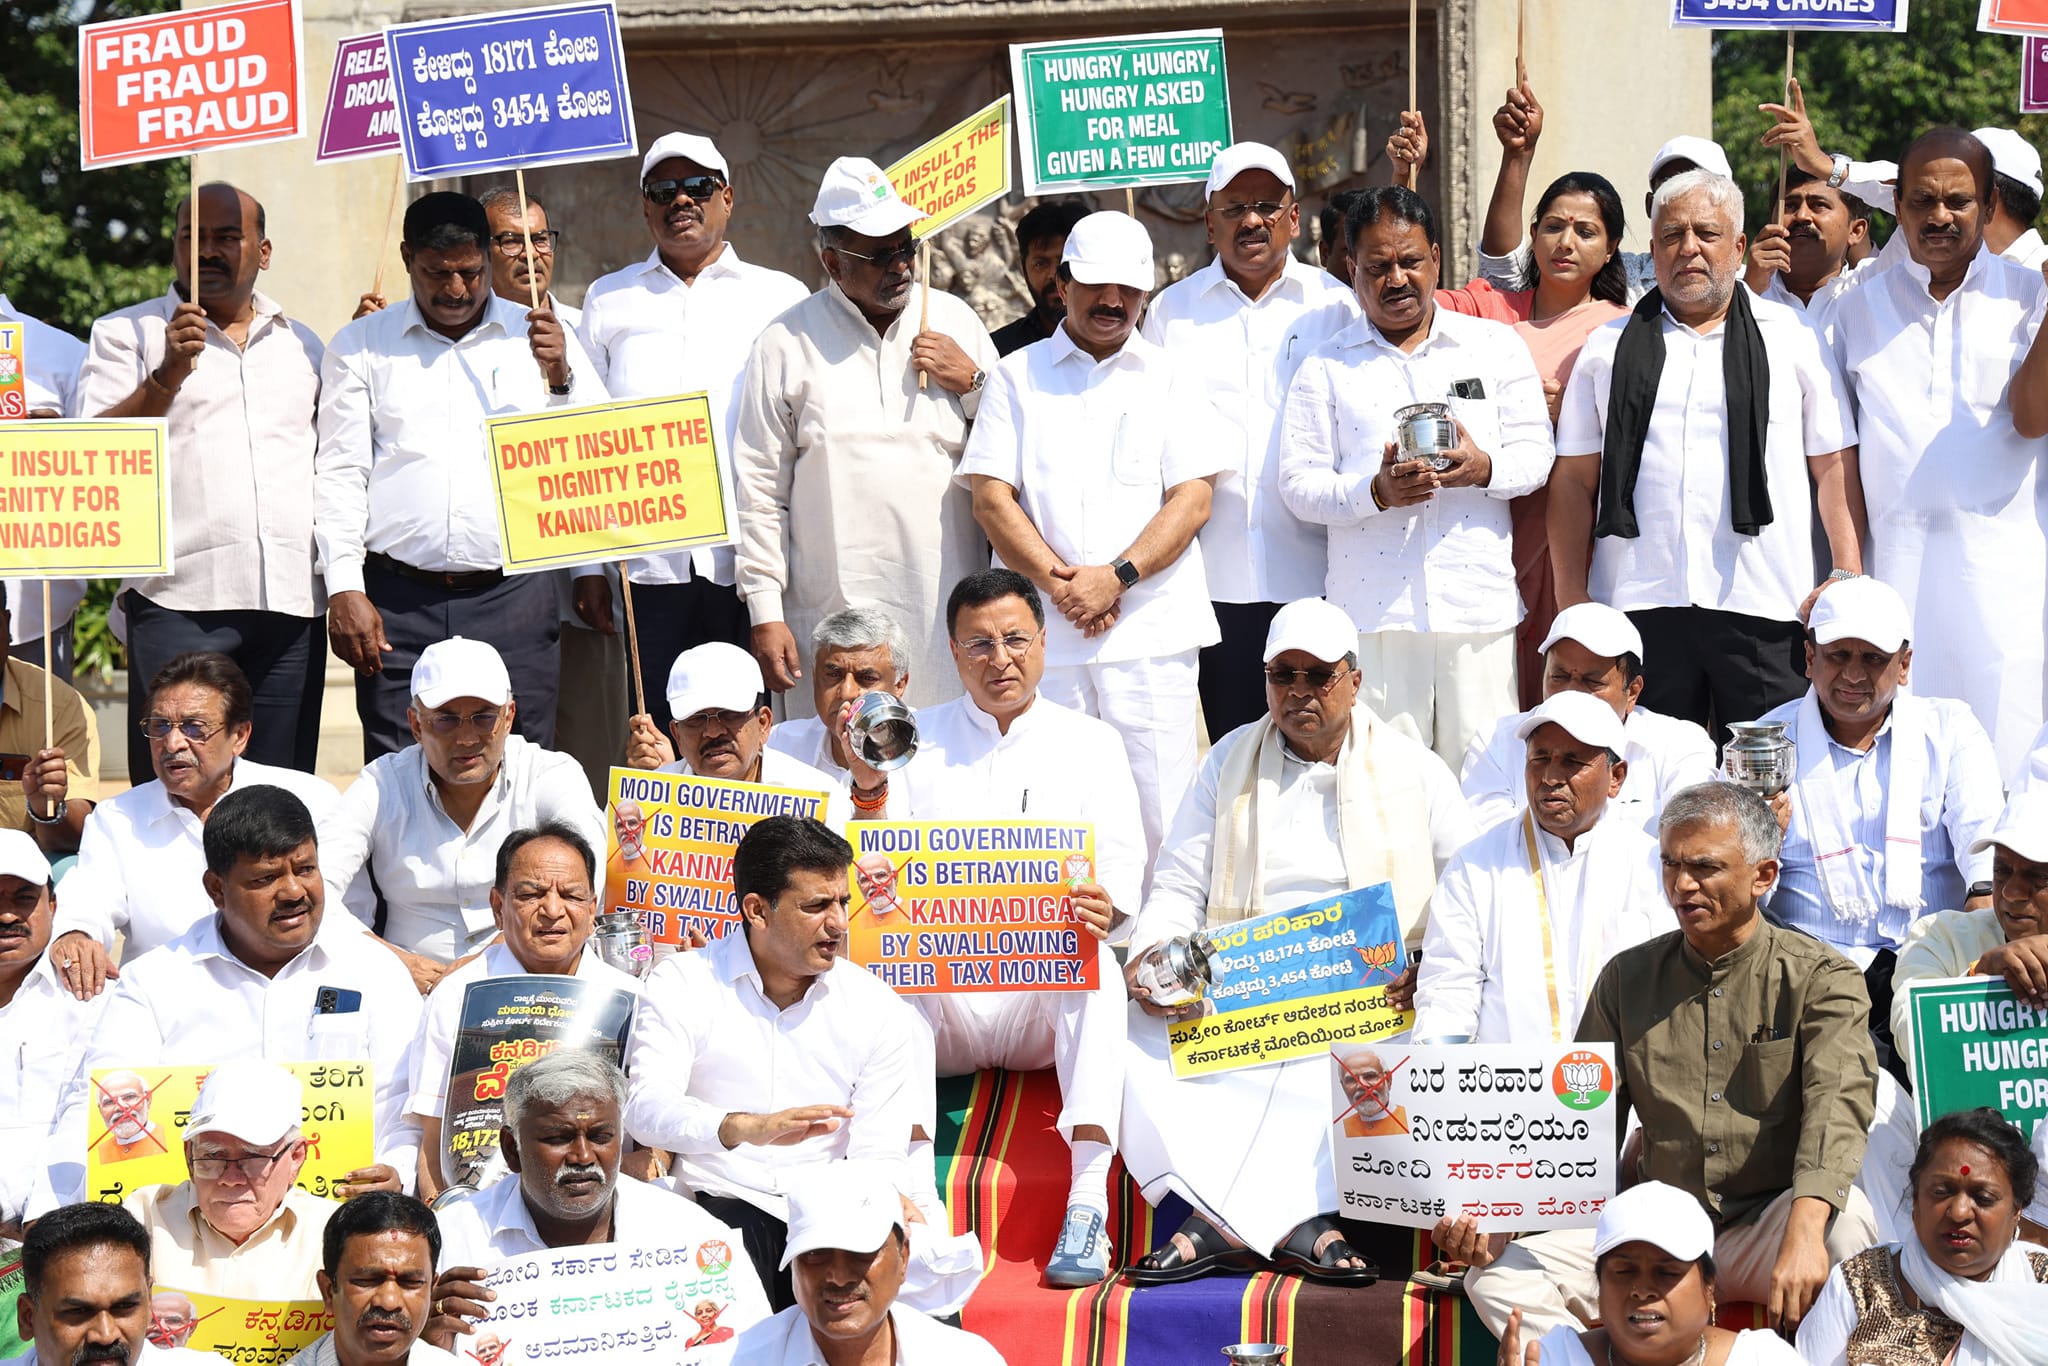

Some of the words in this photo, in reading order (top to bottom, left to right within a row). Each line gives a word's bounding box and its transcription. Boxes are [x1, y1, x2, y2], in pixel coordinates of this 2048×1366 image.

[96, 18, 246, 71] FRAUD
[412, 46, 477, 94] ಕೇಳಿದ್ದು
[481, 38, 537, 75] 18171
[544, 29, 599, 66] ಕೋಟಿ
[1044, 55, 1128, 82] HUNGRY,
[1133, 49, 1216, 76] HUNGRY,
[117, 54, 267, 107] FRAUD
[1061, 84, 1139, 112] HUNGRY
[1144, 80, 1205, 106] ASKED
[138, 91, 289, 144] FRAUD
[416, 101, 488, 151] ಕೊಟ್ಟಿದ್ದು
[492, 93, 550, 129] 3454
[557, 82, 613, 120] ಕೋಟಿ
[1087, 117, 1124, 141] FOR
[1128, 113, 1180, 140] MEAL
[904, 142, 963, 189] INSULT
[967, 119, 1000, 150] THE
[1047, 149, 1104, 175] GIVEN
[1110, 148, 1123, 170] A
[1127, 144, 1165, 169] FEW
[1170, 140, 1222, 167] CHIPS
[944, 155, 976, 187] FOR
[918, 177, 976, 217] DIGAS
[501, 436, 569, 470] DON'T
[575, 425, 656, 461] INSULT
[661, 418, 708, 448] THE
[12, 450, 98, 477] INSULT
[105, 449, 153, 475] THE
[538, 465, 628, 502] DIGNITY
[636, 458, 682, 489] FOR
[73, 485, 120, 512] FOR
[537, 494, 687, 538] KANNADIGAS
[620, 777, 671, 805] MODI
[677, 784, 820, 818] GOVERNMENT
[653, 814, 673, 837] IS
[860, 830, 920, 852] MODI
[929, 828, 1087, 850] GOVERNMENT
[907, 862, 928, 885] IS
[936, 861, 1058, 884] BETRAYING
[627, 880, 650, 903] BY
[679, 914, 717, 940] TAX
[1253, 902, 1343, 941] ಪರಿಹಾರ
[882, 934, 910, 957] BY
[919, 931, 1077, 956] SWALLOWING
[1222, 953, 1260, 974] ಳಿದ್ದು
[1258, 945, 1304, 965] 18,174
[1307, 929, 1357, 953] ಕೋಟಿ
[868, 963, 936, 987] THEIR
[949, 962, 993, 985] TAX
[1000, 960, 1084, 983] MONEY.
[1268, 971, 1307, 989] 3,454
[1309, 960, 1353, 979] ಕೋಟಿ
[1170, 1023, 1221, 1045] ಸುಪ್ರೀಂ
[1224, 1013, 1280, 1034] ಕೋರ್ಟ್
[1284, 1001, 1341, 1023] ಆದೇಶದ
[1344, 994, 1387, 1014] ನಂತರ
[1187, 1042, 1266, 1065] ಕರ್ನಾಟಕಕ್ಕೆ
[1264, 1024, 1356, 1052] ಮೋದಿಯಿಂದ
[1359, 1015, 1404, 1036] ಮೋಸ
[310, 1065, 364, 1088] ತೆರಿಗೆ
[1410, 1060, 1445, 1093] ಬರ
[1458, 1059, 1543, 1093] ಪರಿಹಾರ
[1999, 1078, 2048, 1110] FOR
[1412, 1112, 1589, 1154] ನೀಡುವಲ್ಲಿಯೂ
[1352, 1152, 1431, 1179] ಮೋದಿ
[1447, 1157, 1597, 1180] ಸರ್ಕಾರದಿಂದ
[1461, 1198, 1524, 1218] ಮಹಾ
[1537, 1196, 1606, 1217] ಮೋಸ
[486, 1261, 539, 1287] ಮೋದಿ
[551, 1252, 617, 1276] ಸರ್ಕಾರ
[629, 1245, 688, 1269] ಸೇಡಿನ
[550, 1285, 653, 1315] ಕರ್ನಾಟಕದ
